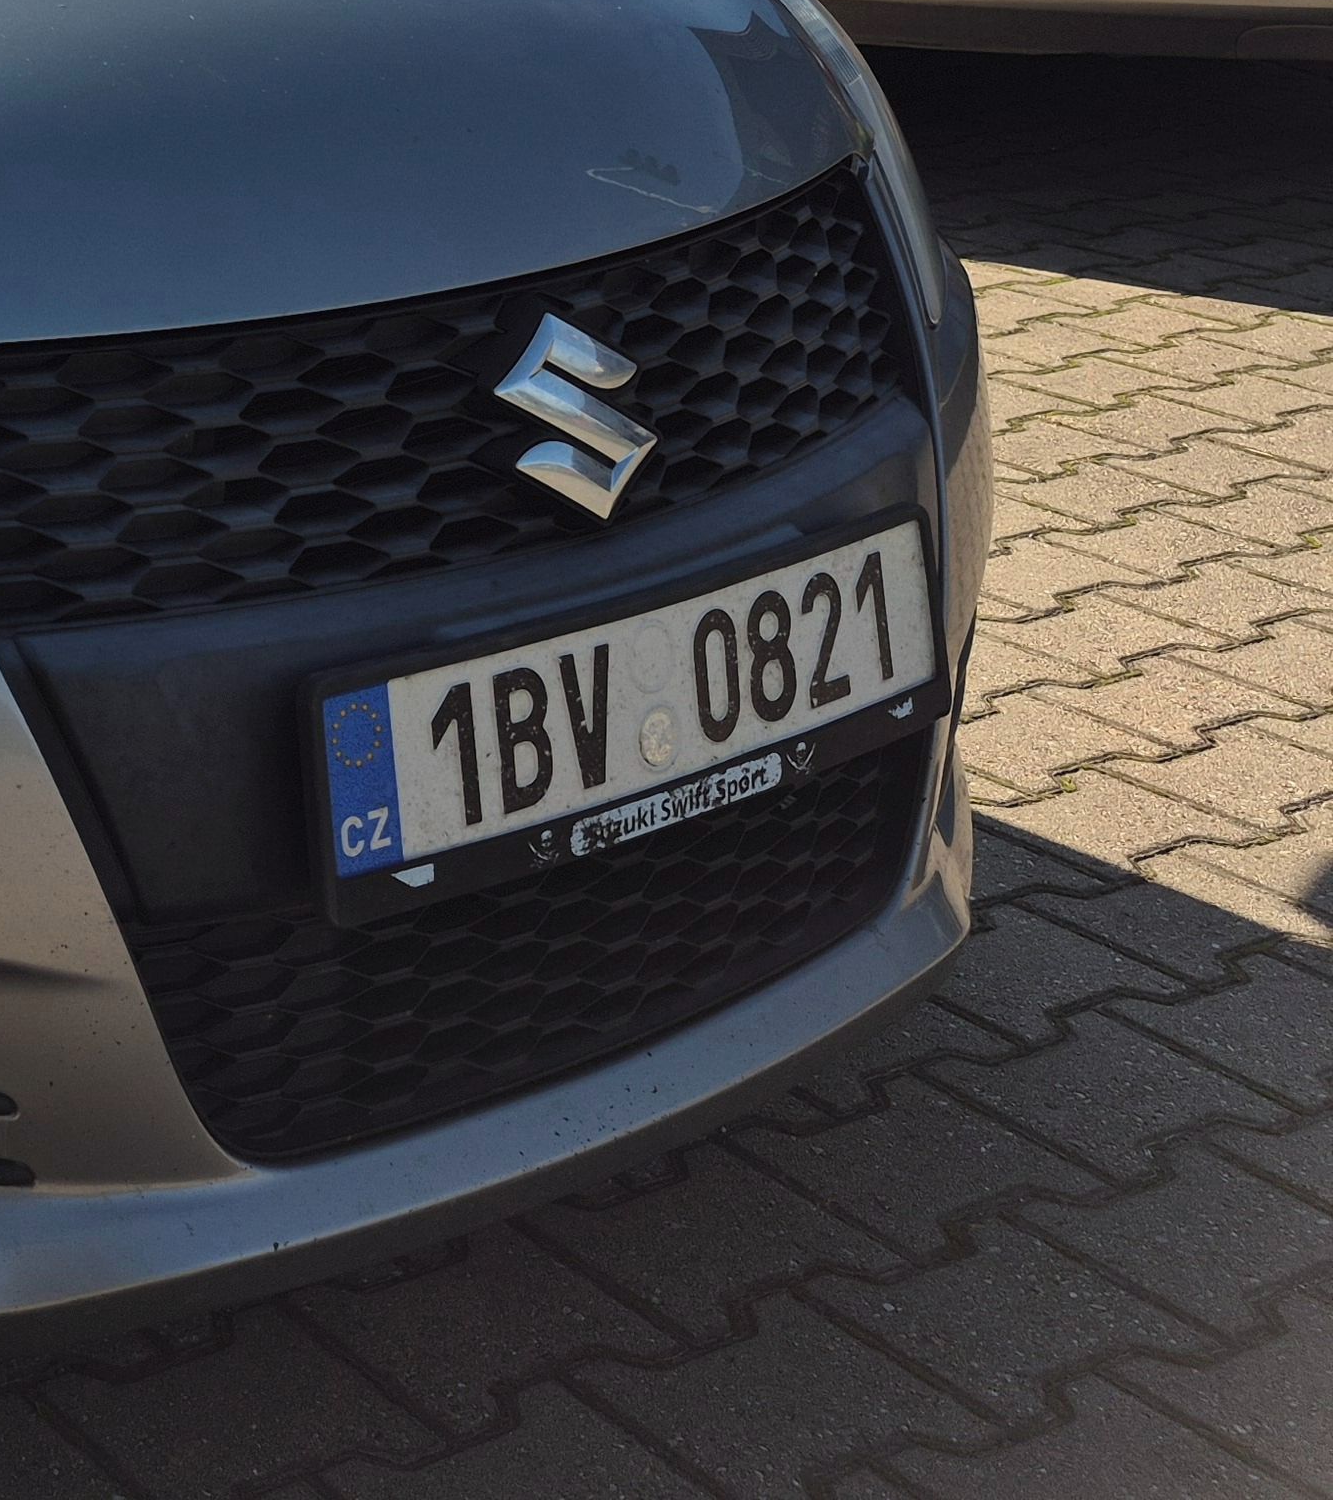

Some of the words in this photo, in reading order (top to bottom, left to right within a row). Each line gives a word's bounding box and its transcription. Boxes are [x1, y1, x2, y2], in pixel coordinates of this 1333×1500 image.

[430, 643, 610, 826] 1BV
[692, 551, 894, 743] 0821
[660, 775, 712, 821] Swift
[715, 764, 769, 806] Sport
[340, 807, 393, 858] CZ
